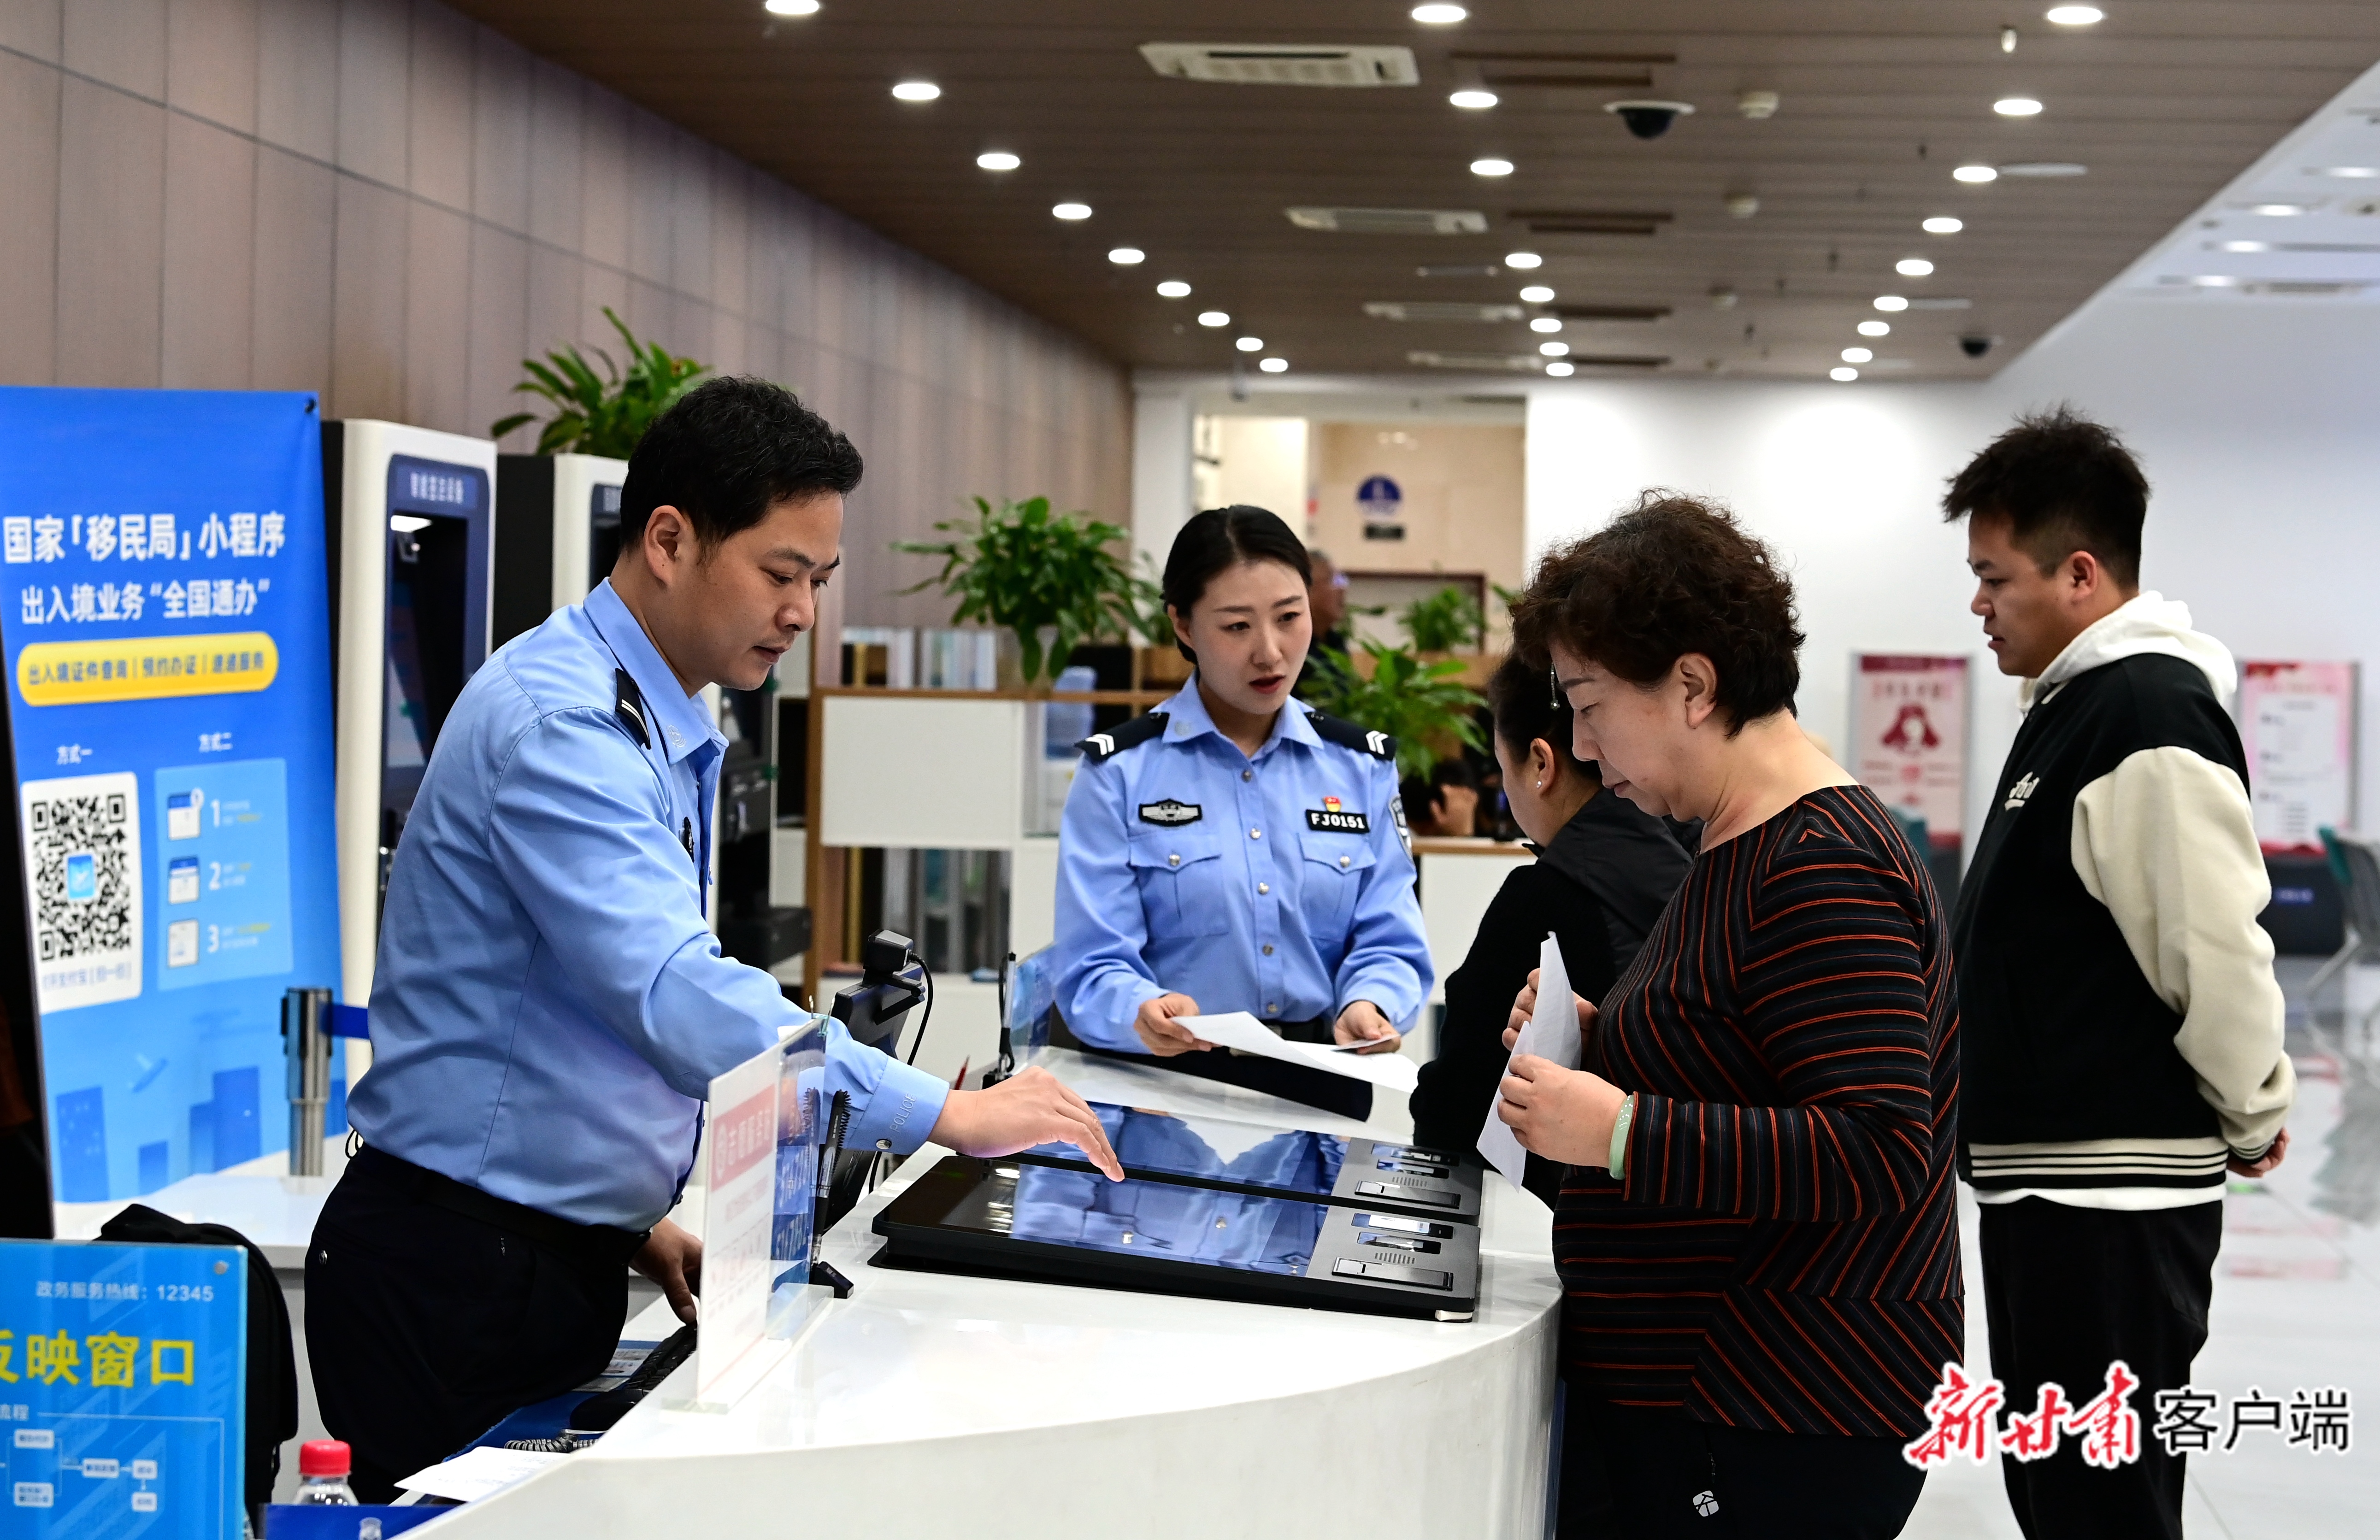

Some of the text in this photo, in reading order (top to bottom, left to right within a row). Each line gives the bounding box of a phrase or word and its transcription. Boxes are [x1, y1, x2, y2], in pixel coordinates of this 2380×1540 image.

[3, 511, 286, 564] 国家「移民局」小程序
[21, 578, 270, 625] 出入境业务“全国通办”
[211, 800, 220, 828] 1
[1311, 812, 1365, 829] FJ0151
[209, 861, 221, 890] 2
[208, 925, 219, 952] 3
[889, 1092, 917, 1134] POLICE
